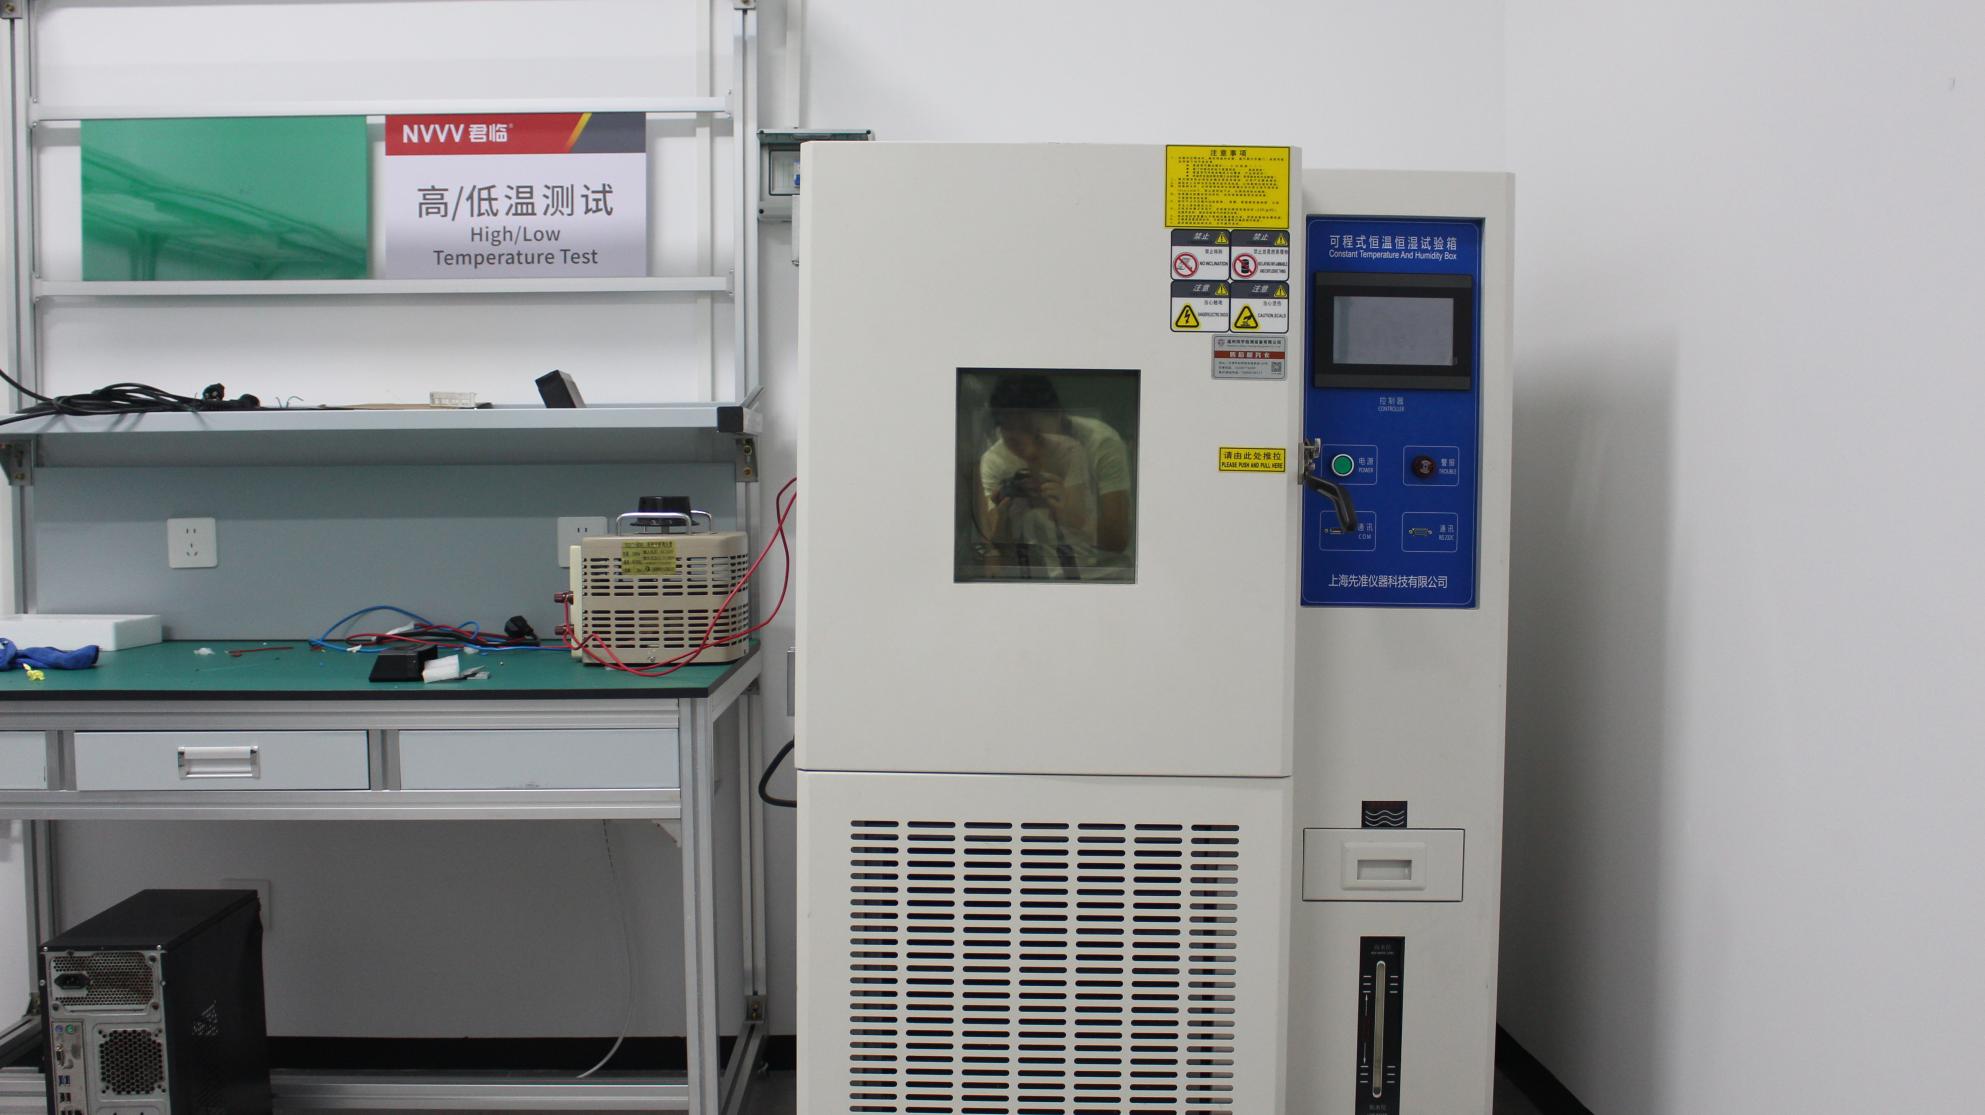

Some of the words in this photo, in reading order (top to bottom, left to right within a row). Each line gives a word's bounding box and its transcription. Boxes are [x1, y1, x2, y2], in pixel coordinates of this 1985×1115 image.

[403, 124, 464, 143] NVVV
[469, 123, 508, 143] 君临
[1210, 149, 1248, 157] 注意事项
[417, 183, 614, 221] 高/低温测试
[470, 226, 560, 246] High/Low
[1193, 232, 1210, 240] 禁止
[1252, 233, 1268, 241] 禁止
[1329, 235, 1457, 251] 可程式恒温恒湿试验箱
[433, 250, 555, 269] Temperature
[560, 249, 598, 264] Test
[1329, 250, 1358, 258] Constant
[1360, 250, 1400, 259] Temperature
[1400, 251, 1414, 259] And
[1415, 251, 1443, 261] Humidity
[1444, 252, 1457, 260] Box
[1193, 284, 1211, 292] 注意
[1252, 285, 1268, 293] 注意
[1224, 451, 1281, 460] 请由此处推拉
[1358, 457, 1374, 466] 电源
[1439, 525, 1454, 533] 通讯
[1328, 574, 1448, 589] 上海先准仪器科技有限公司
